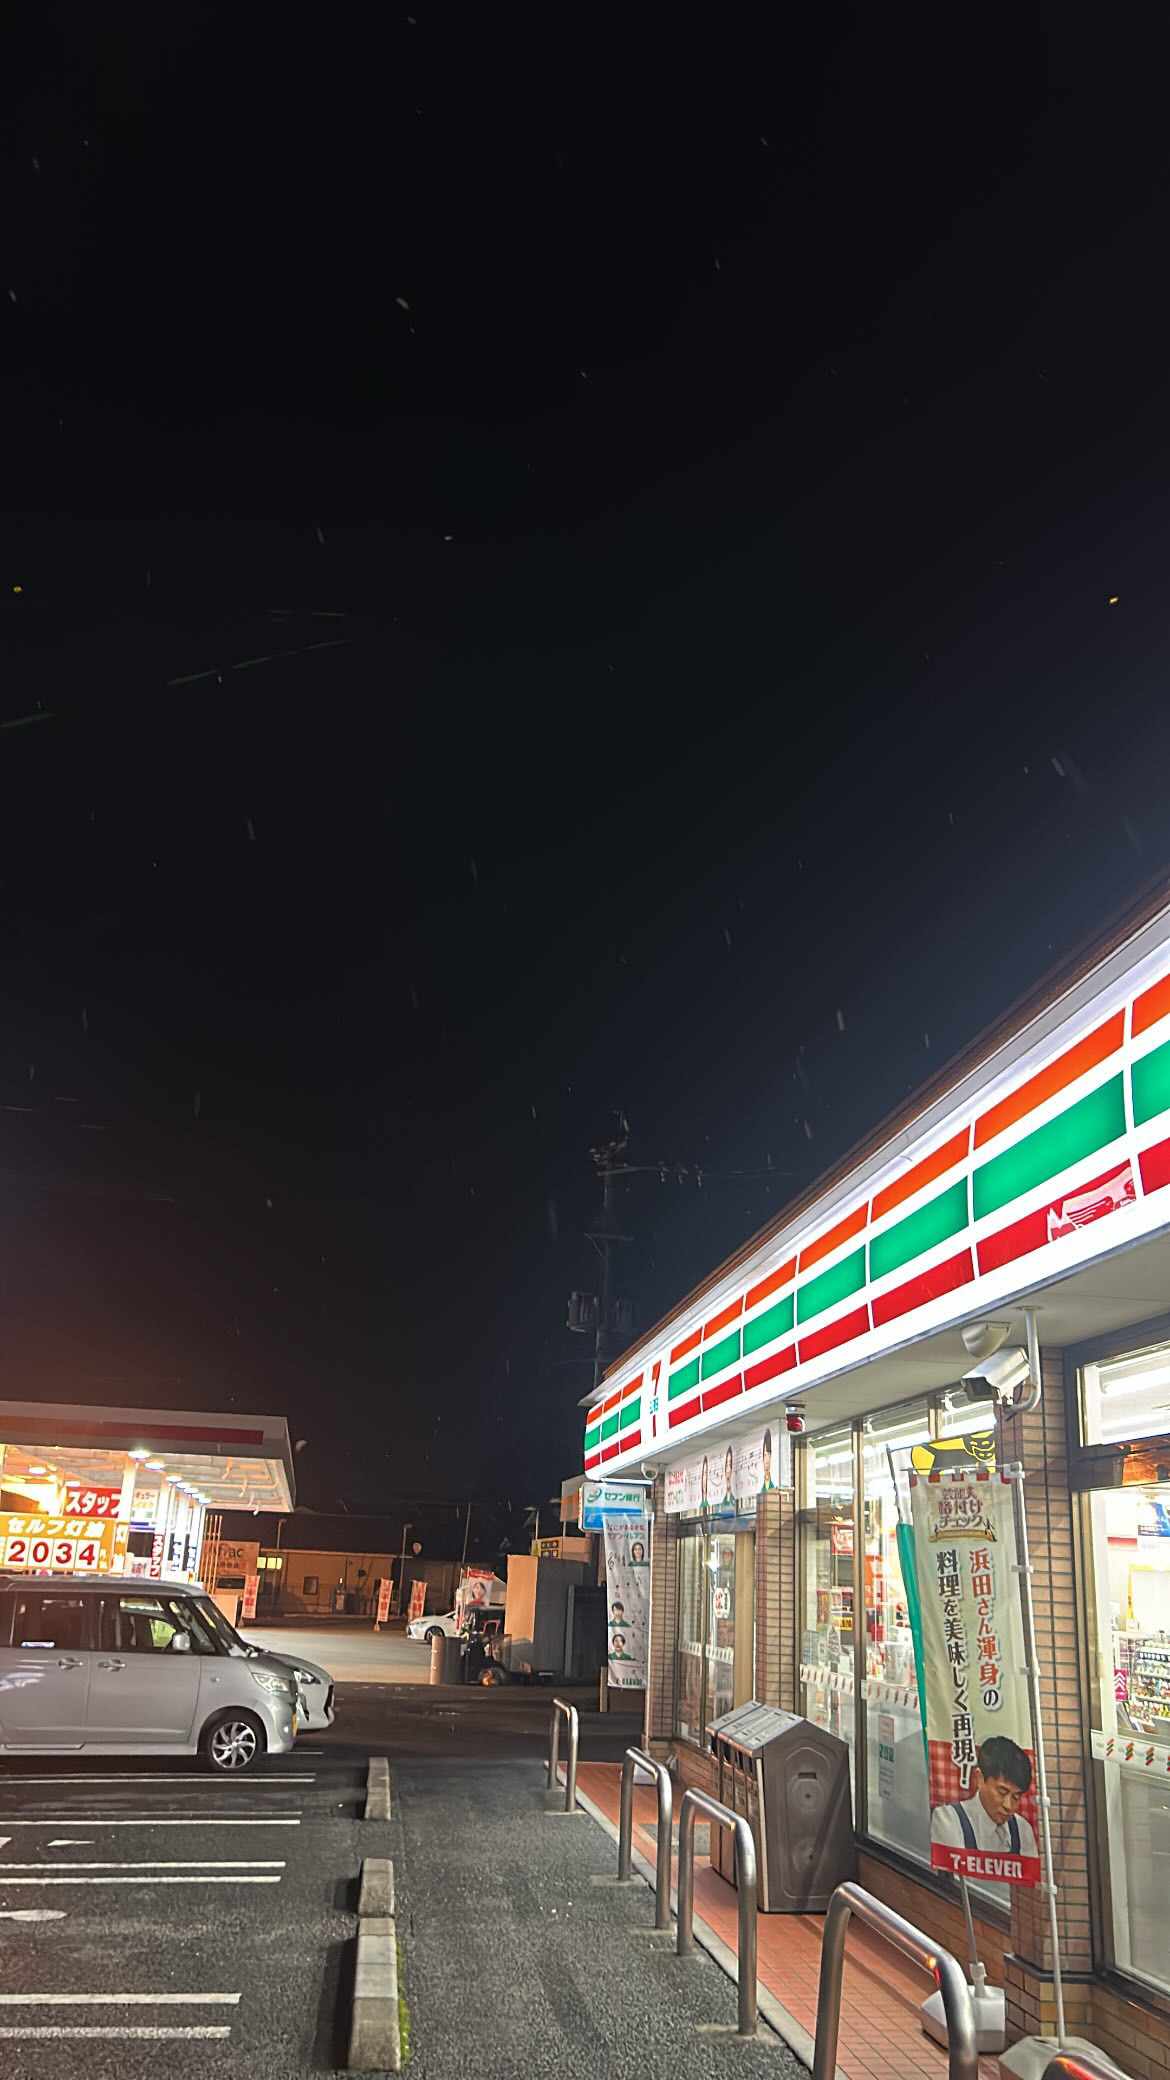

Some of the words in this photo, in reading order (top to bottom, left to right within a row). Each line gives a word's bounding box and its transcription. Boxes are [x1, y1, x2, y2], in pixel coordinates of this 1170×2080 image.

[605, 1492, 640, 1502] セブン銀行
[938, 1500, 983, 1515] 格付け
[939, 1514, 983, 1528] チェック
[8, 1540, 96, 1566] 2034
[969, 1547, 999, 1707] 浜田さん渾身の
